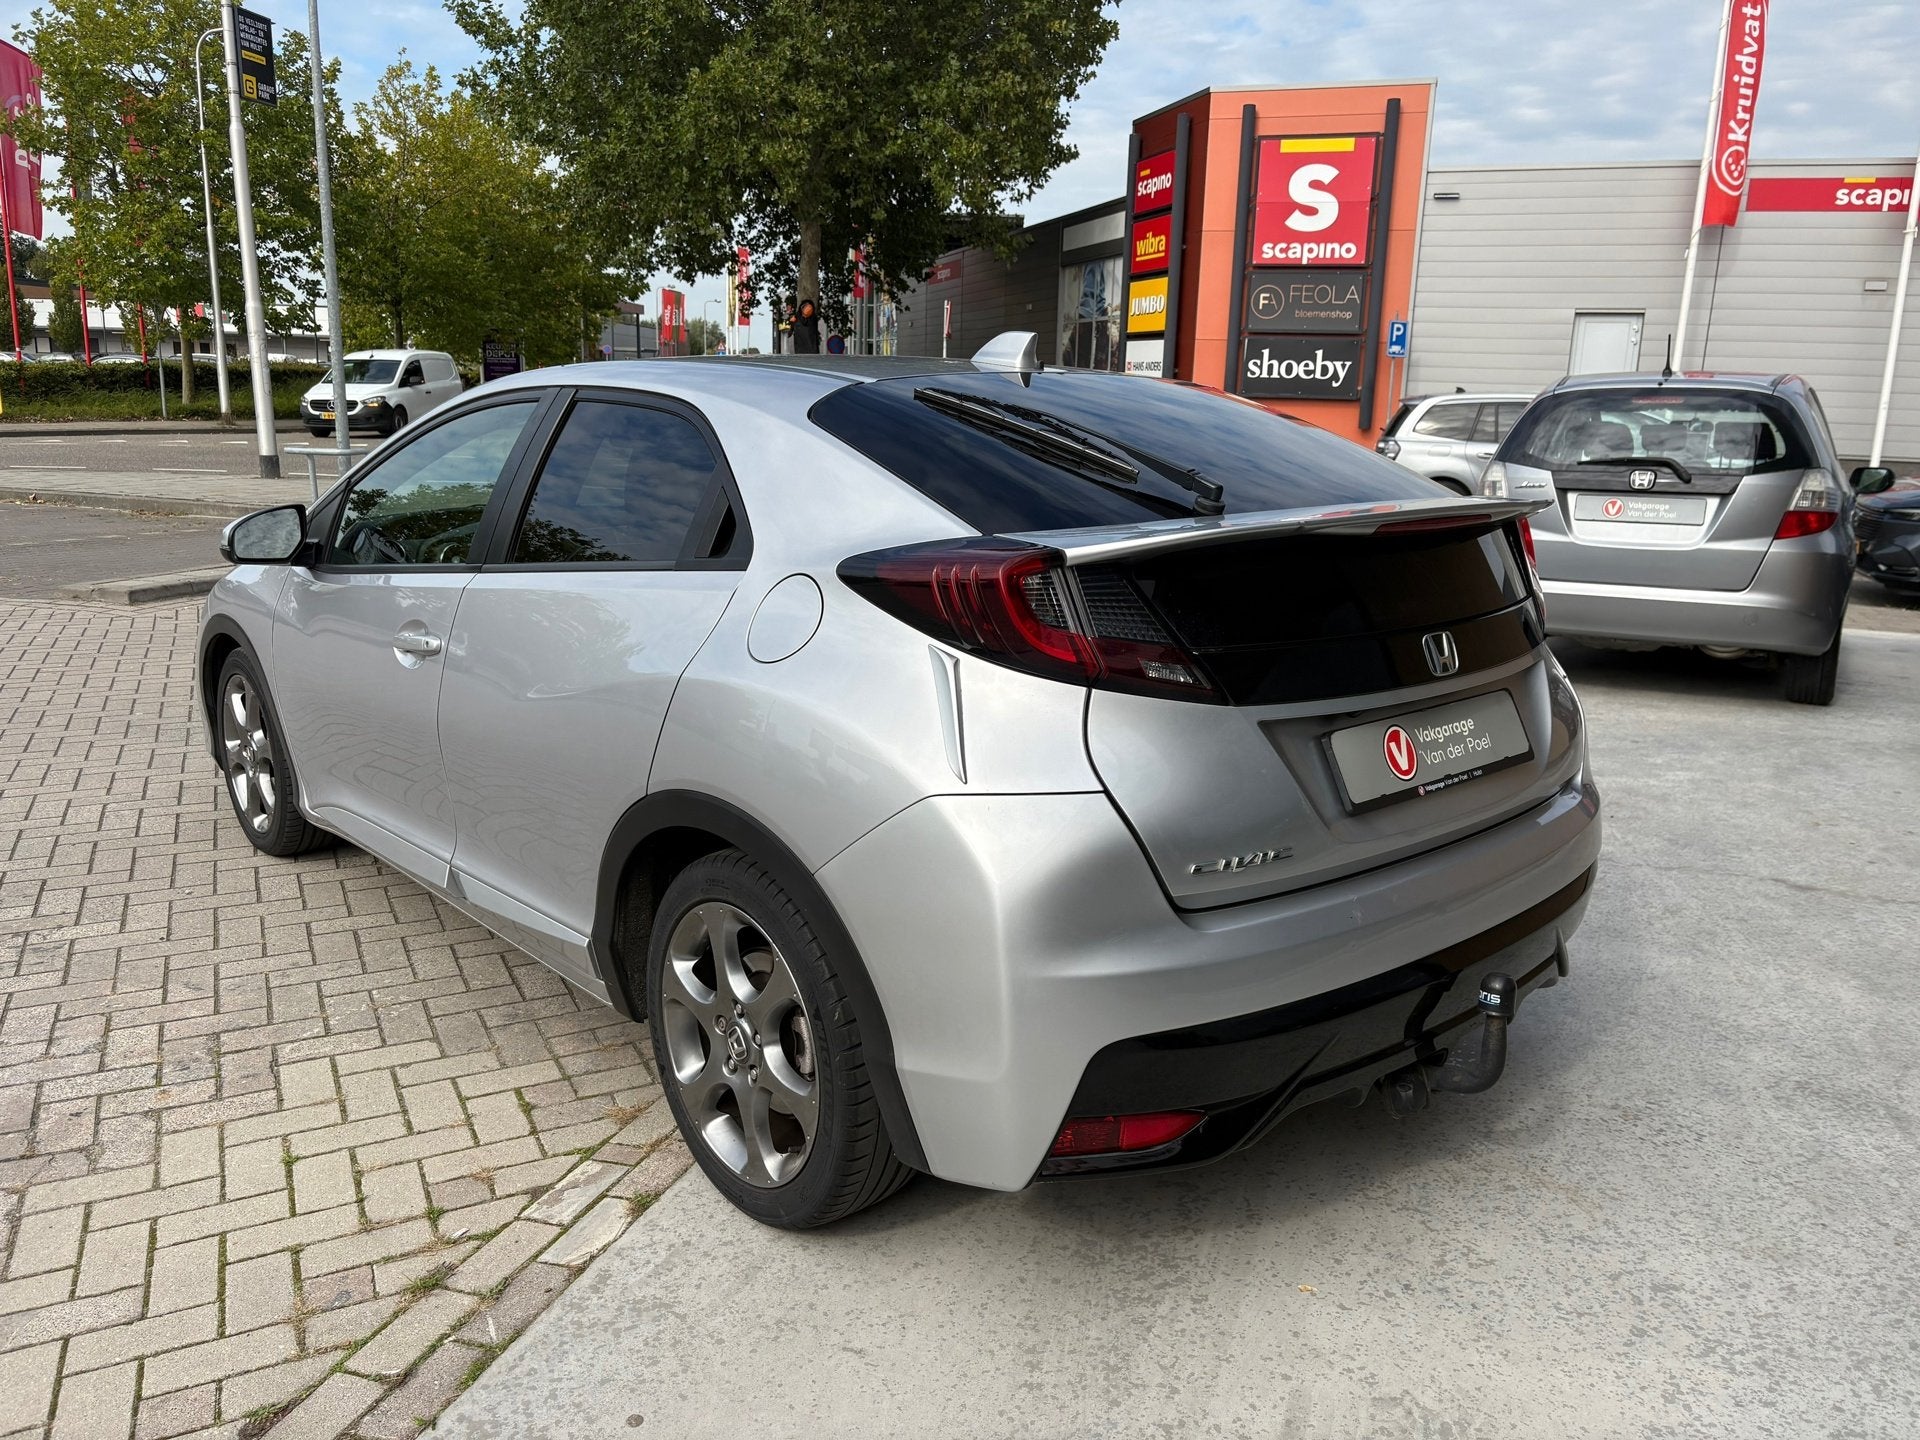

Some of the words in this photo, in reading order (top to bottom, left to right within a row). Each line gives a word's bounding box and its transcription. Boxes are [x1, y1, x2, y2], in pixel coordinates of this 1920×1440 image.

[1727, 3, 1761, 142] Kruidvat
[258, 90, 270, 100] PARK
[1137, 171, 1172, 199] scapino
[1136, 231, 1166, 256] wibra
[1261, 241, 1357, 265] scapino
[1130, 294, 1165, 316] JUMBO
[1289, 284, 1360, 304] FEOLA
[1294, 309, 1353, 320] bloemenshop
[1392, 323, 1404, 342] P
[1133, 361, 1144, 371] HANS
[1145, 361, 1162, 371] ANDERS
[1247, 348, 1353, 387] shoeby
[1627, 509, 1643, 517] Van
[1644, 510, 1657, 518] der
[1659, 511, 1677, 519] Poel
[1628, 501, 1670, 511] Vakgarage
[1415, 718, 1475, 743] Vakgarage
[1421, 748, 1446, 765] Van
[1448, 742, 1466, 759] der
[1467, 732, 1492, 753] Poel
[1189, 848, 1294, 875] CIVIC
